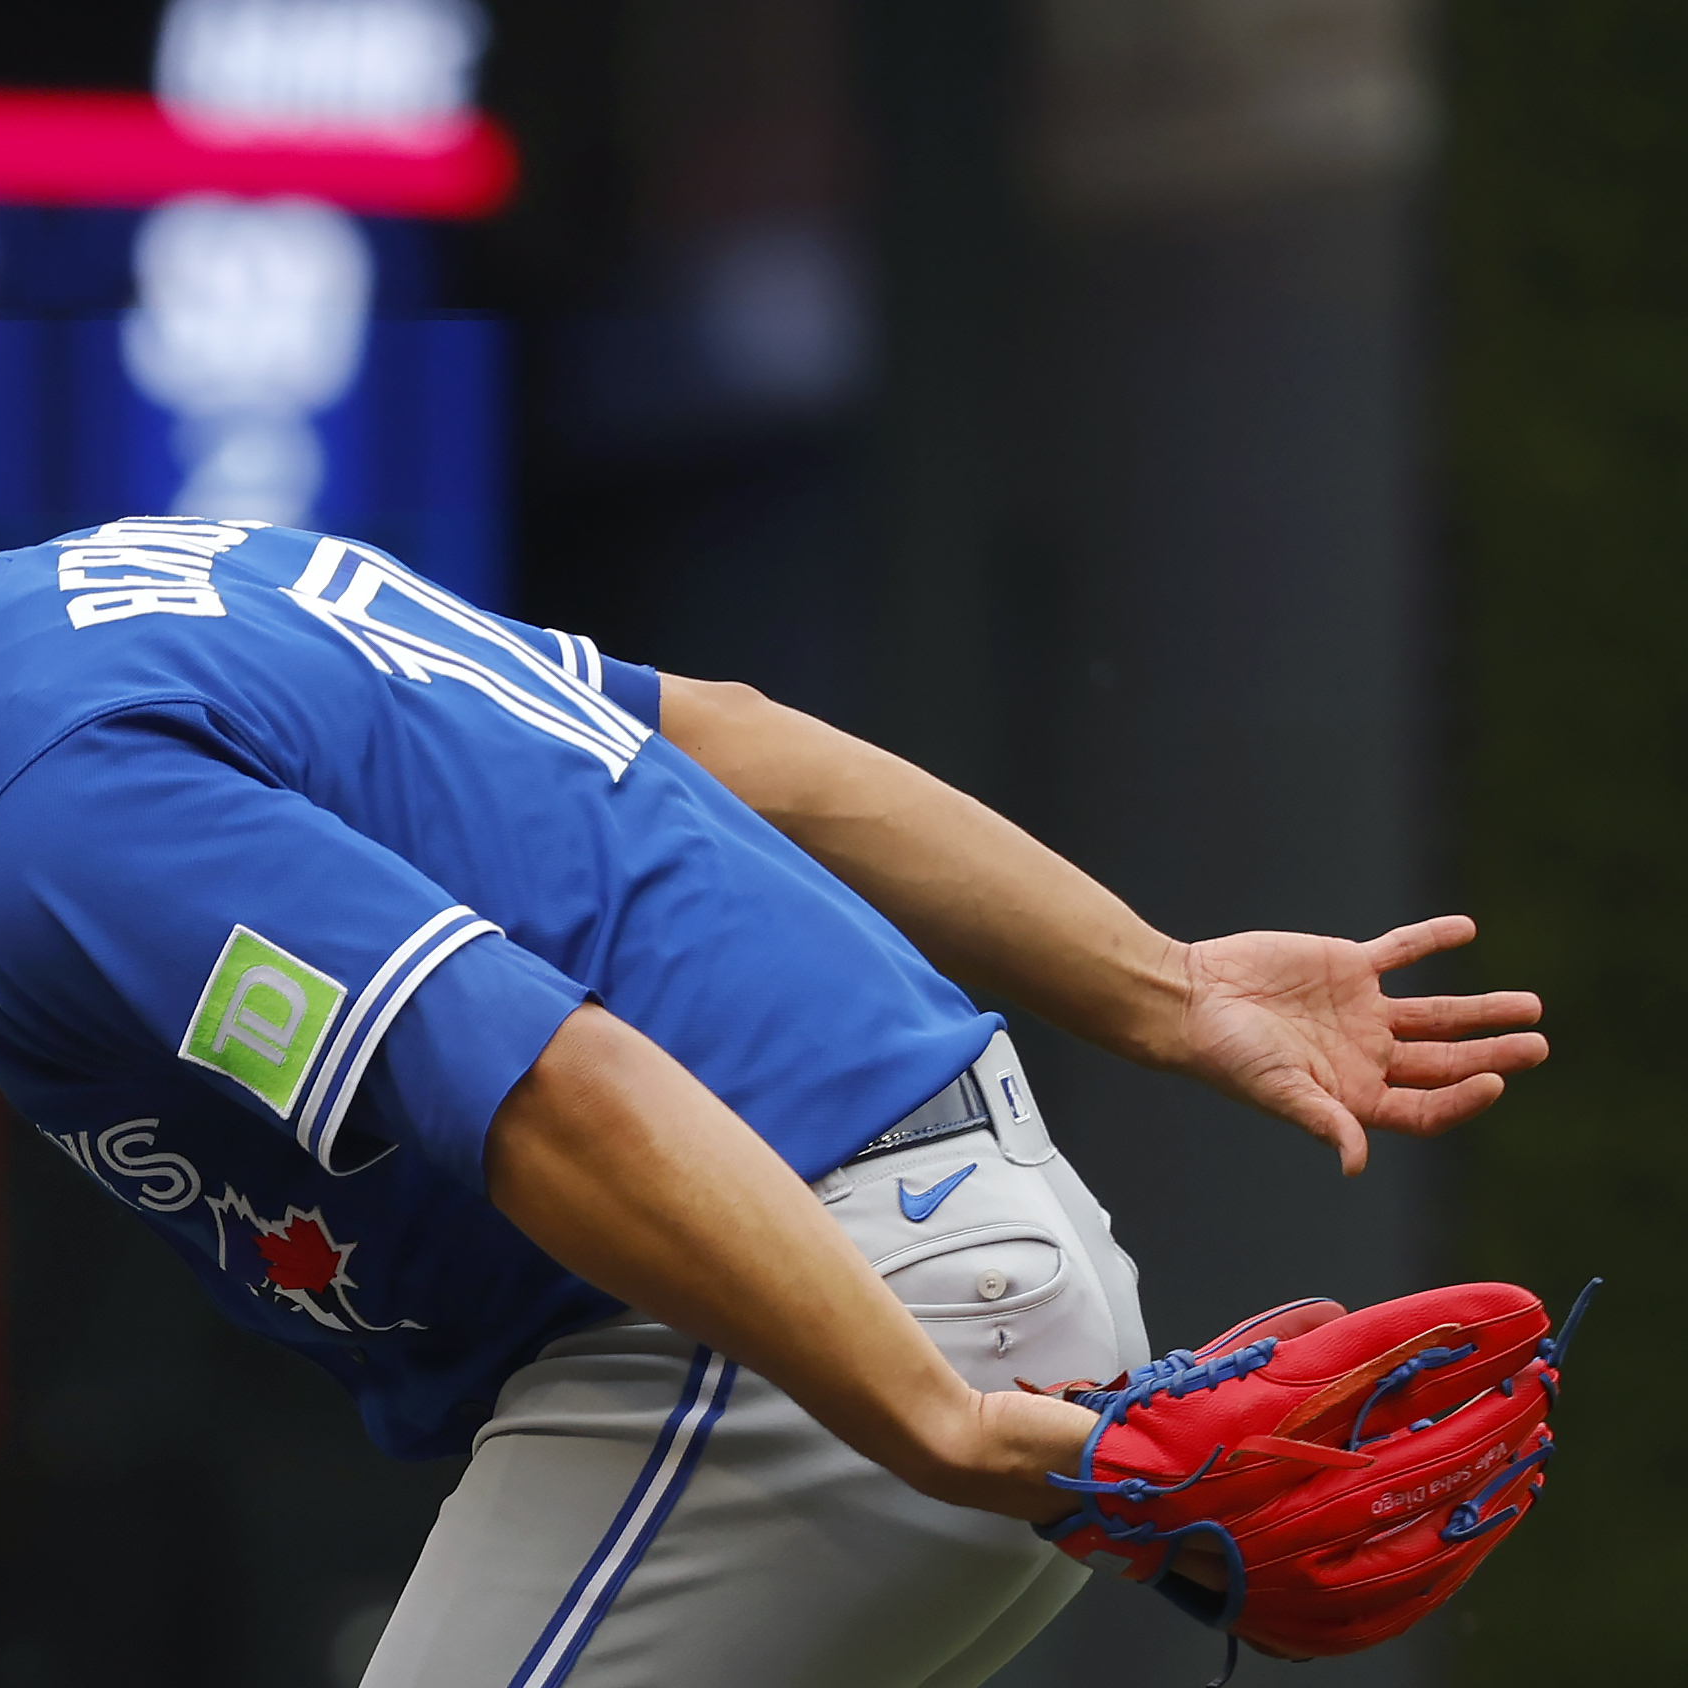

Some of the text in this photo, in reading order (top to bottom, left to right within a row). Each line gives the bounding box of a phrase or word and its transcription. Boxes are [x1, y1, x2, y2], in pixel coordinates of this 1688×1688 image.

[277, 536, 654, 784] 17
[211, 964, 308, 1067] TD
[1370, 1485, 1426, 1515] Diego
[1429, 1465, 1473, 1494] Seba
